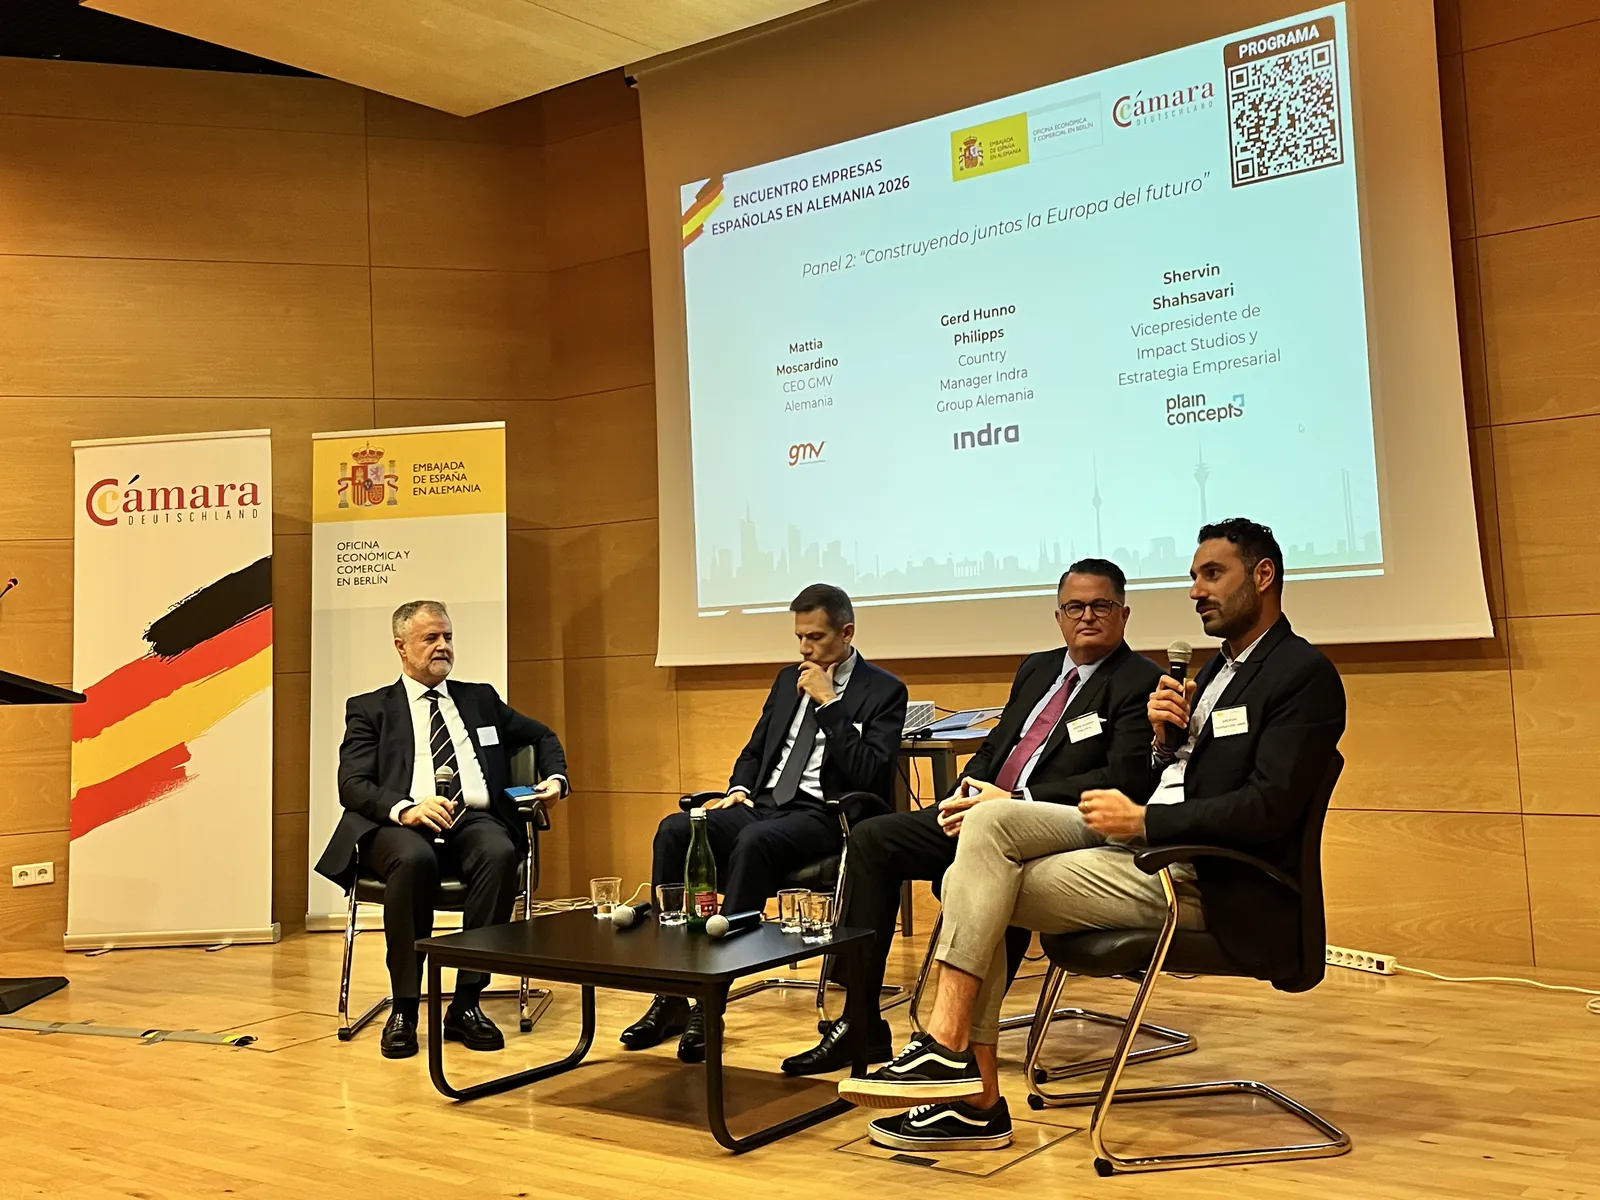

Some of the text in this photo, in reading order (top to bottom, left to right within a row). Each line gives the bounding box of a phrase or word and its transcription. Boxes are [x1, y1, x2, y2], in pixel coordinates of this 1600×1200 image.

[1238, 24, 1320, 59] PROGRAMA
[1136, 100, 1213, 126] DEUTSCHLAND
[733, 159, 882, 208] ENCUENTRO EMPRESAS
[711, 175, 910, 236] ESPAÑOLAS EN ALEMANIA 2026
[802, 255, 842, 278] Panel
[844, 253, 856, 269] 2:
[970, 219, 1022, 245] juntos
[1027, 212, 1042, 229] la
[1047, 199, 1109, 225] Europa
[1113, 187, 1141, 209] del
[1163, 263, 1221, 285] Shervin
[1152, 282, 1235, 310] Shahsavari
[940, 303, 1016, 327] Gerd Hunno
[1130, 304, 1261, 338] Vicepresidente de
[789, 338, 823, 354] Mattia
[954, 327, 1005, 346] Philipps
[1136, 331, 1258, 360] Impact Studios y
[776, 356, 839, 376] Moscardino
[958, 349, 1007, 368] Country
[1118, 348, 1281, 386] Estrategia Empresarial
[782, 374, 834, 393] CEO GMV
[940, 366, 1028, 392] Manager Indra
[784, 395, 833, 413] Alemania
[936, 387, 1034, 413] Group Alemania
[1166, 393, 1206, 414] plain
[1166, 402, 1244, 427] concepts
[953, 422, 1020, 450] indra
[788, 440, 827, 467] gmv
[413, 461, 465, 473] EMBAJADA
[413, 472, 468, 484] DE ESPAÑA
[86, 474, 262, 527] Cámara
[413, 484, 481, 496] EN ALEMANIA
[128, 508, 258, 526] DEUTSCHLAND
[336, 540, 380, 551] OFICINA
[336, 550, 411, 563] ECONÓMICA Y
[336, 563, 397, 575] COMERCIAL
[336, 574, 388, 587] EN BERLÍN
